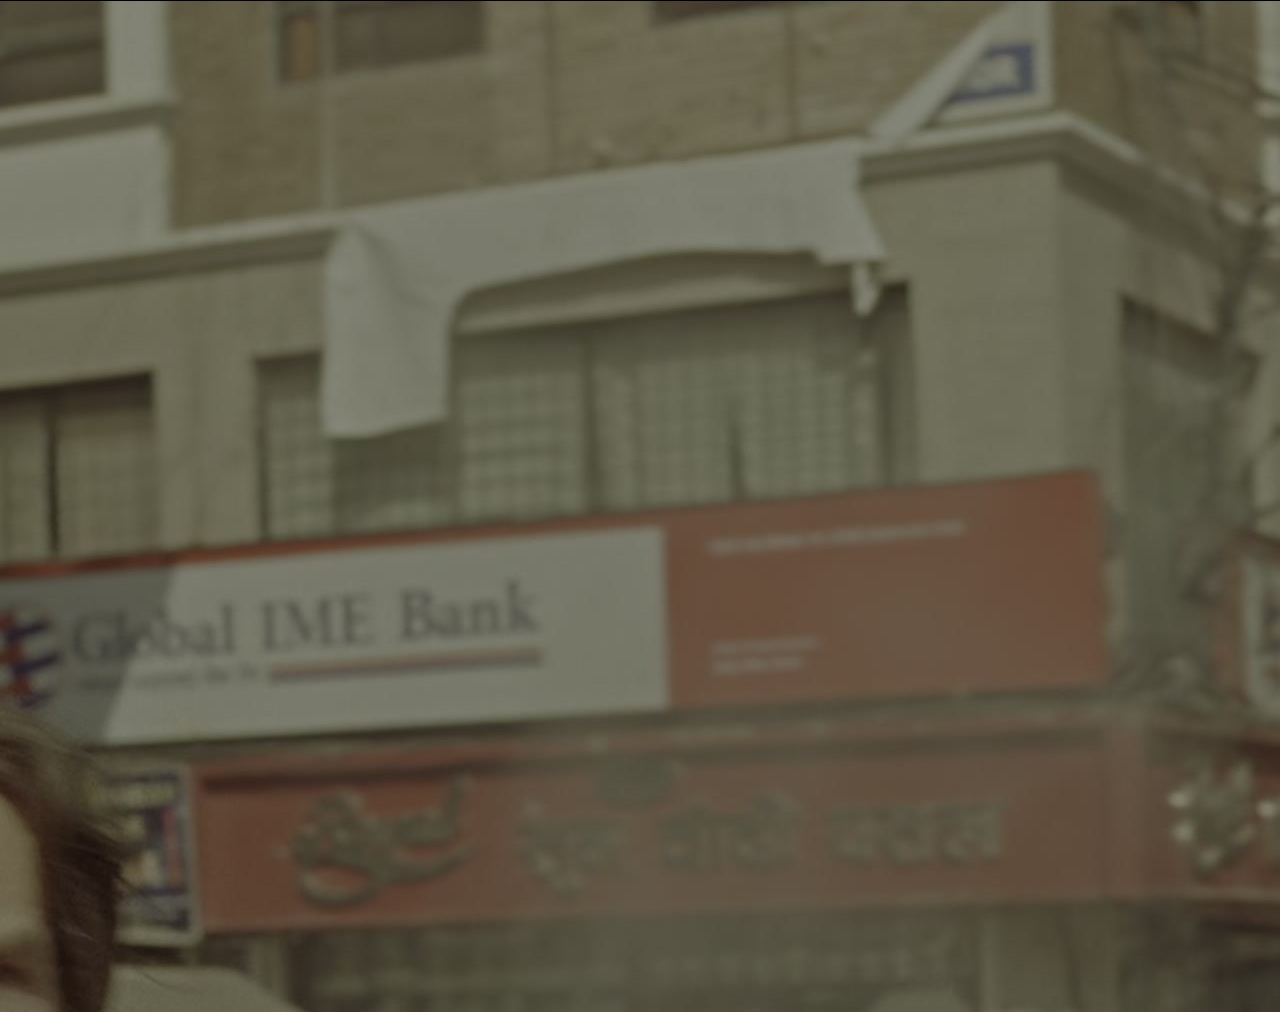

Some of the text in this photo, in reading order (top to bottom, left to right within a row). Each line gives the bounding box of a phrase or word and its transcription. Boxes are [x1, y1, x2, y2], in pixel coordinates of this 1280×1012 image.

[72, 577, 538, 663] Global IME Bank
